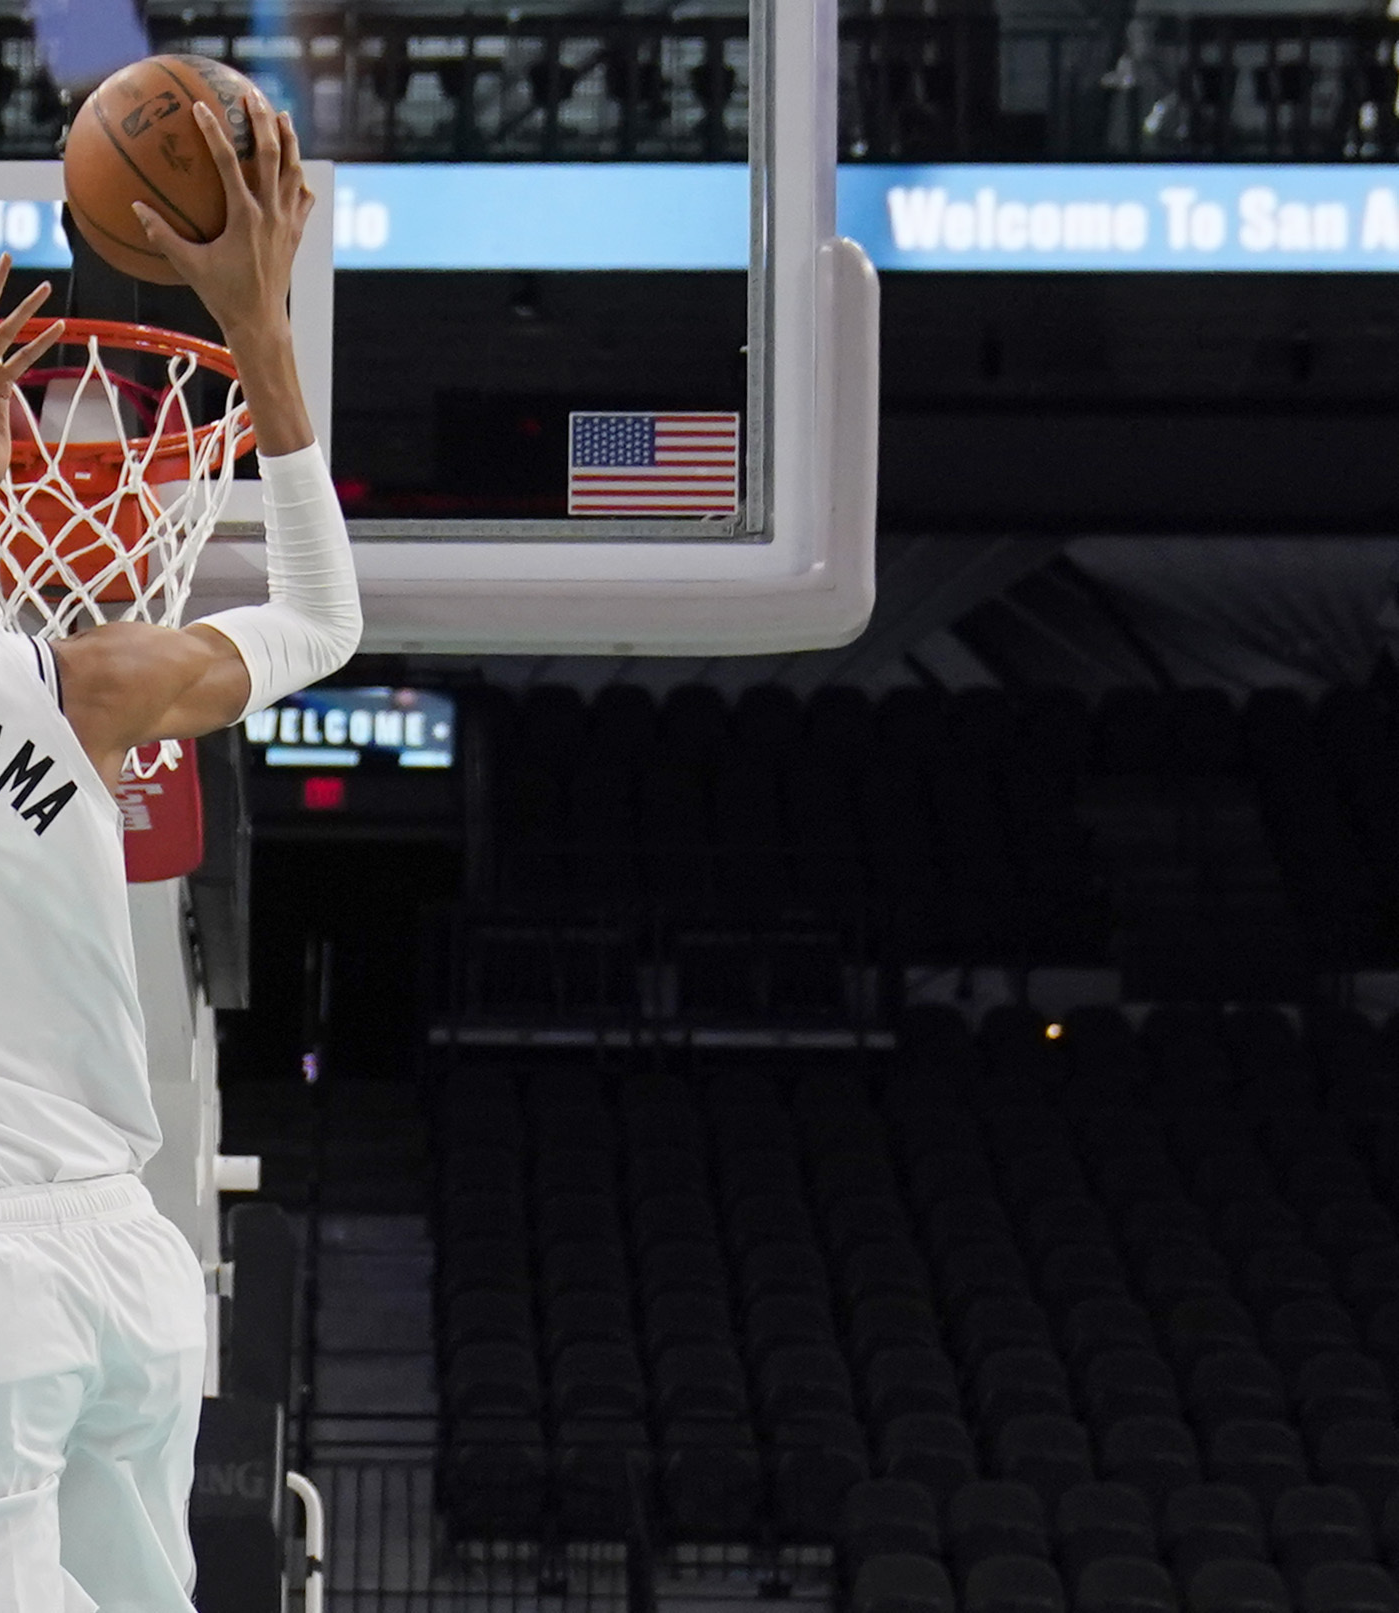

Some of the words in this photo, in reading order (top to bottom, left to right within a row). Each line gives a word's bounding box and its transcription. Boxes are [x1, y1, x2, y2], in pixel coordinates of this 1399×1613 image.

[887, 186, 1148, 253] Welcome
[1159, 187, 1226, 253] To
[1238, 186, 1349, 253] San
[245, 706, 426, 746] WELCOME
